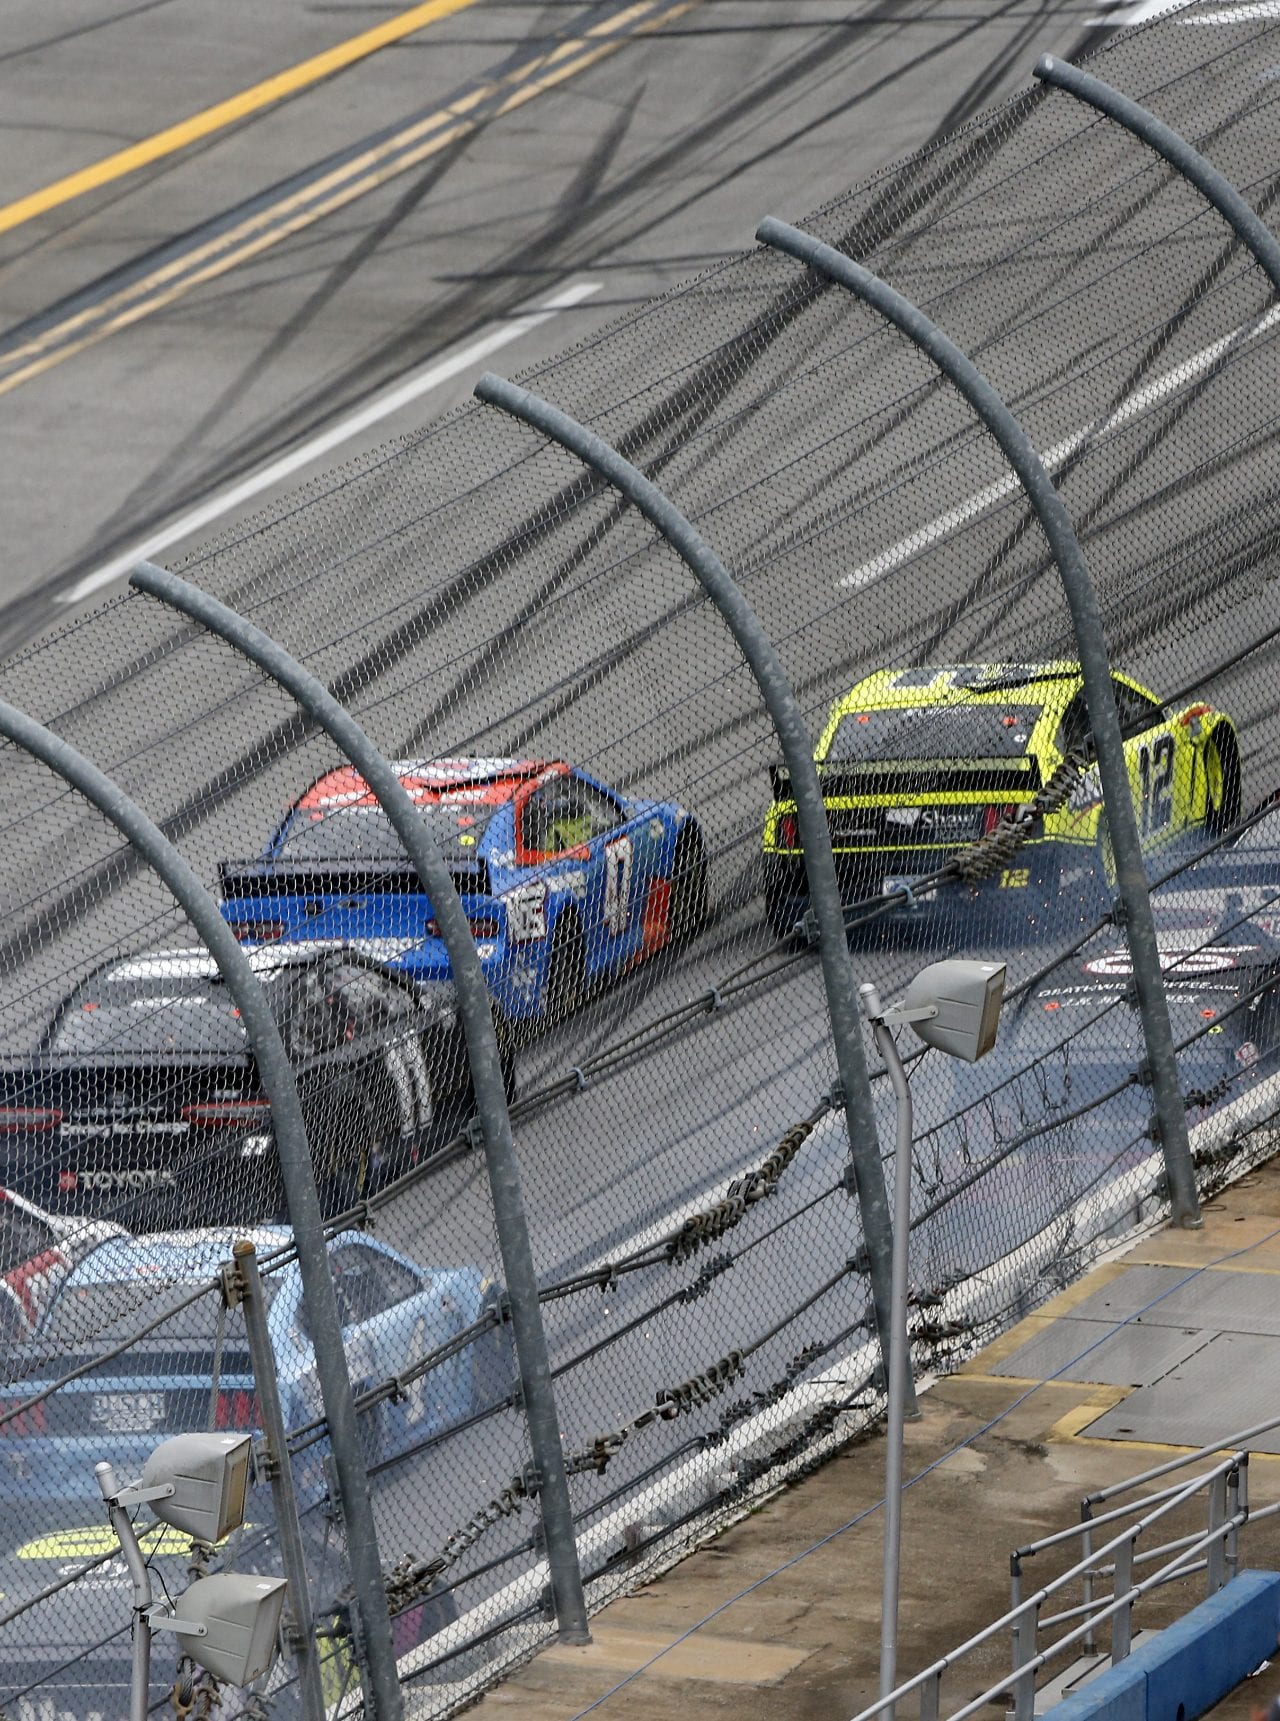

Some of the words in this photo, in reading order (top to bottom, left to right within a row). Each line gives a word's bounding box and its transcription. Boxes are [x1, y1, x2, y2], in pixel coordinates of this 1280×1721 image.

[1139, 733, 1176, 840] 12
[999, 867, 1031, 889] 12
[78, 1170, 176, 1190] TOYOTA
